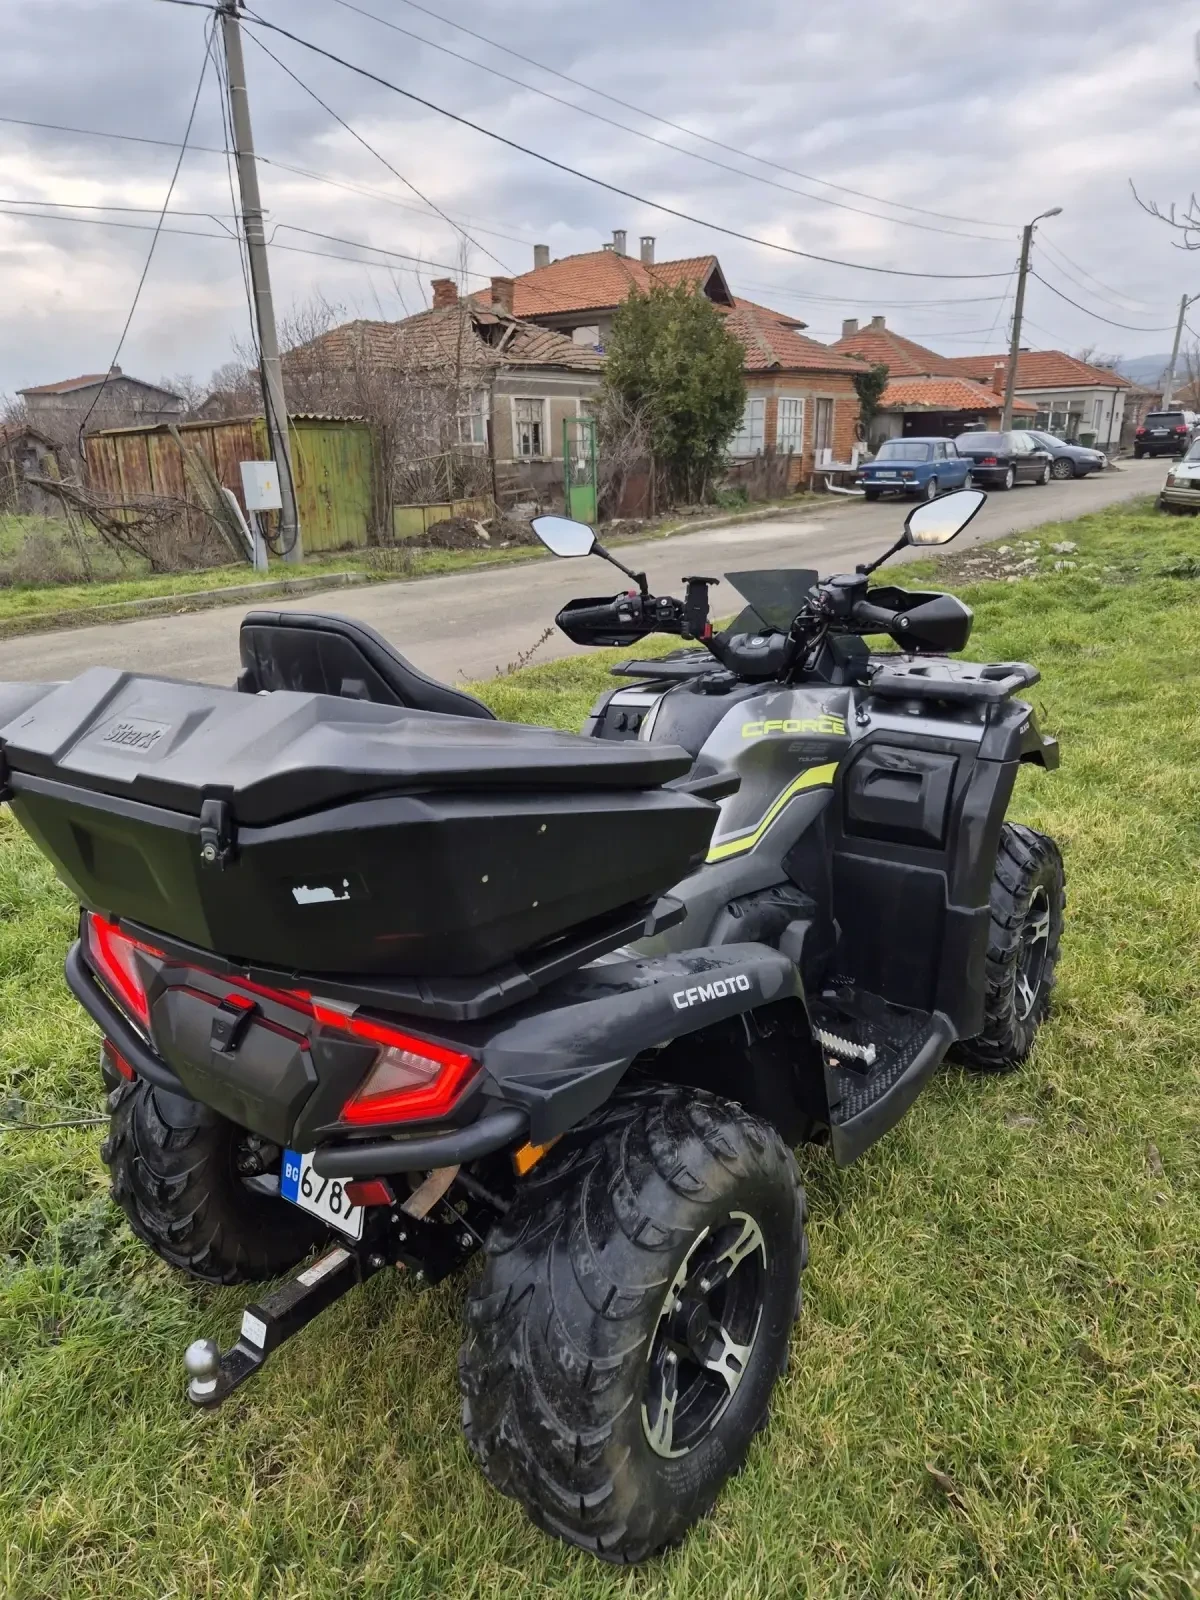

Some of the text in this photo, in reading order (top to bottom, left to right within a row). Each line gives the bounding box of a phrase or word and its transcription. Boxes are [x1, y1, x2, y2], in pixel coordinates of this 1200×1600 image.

[741, 714, 846, 738] CFORCE
[673, 974, 750, 1009] CFMOTO
[285, 1163, 299, 1182] BG
